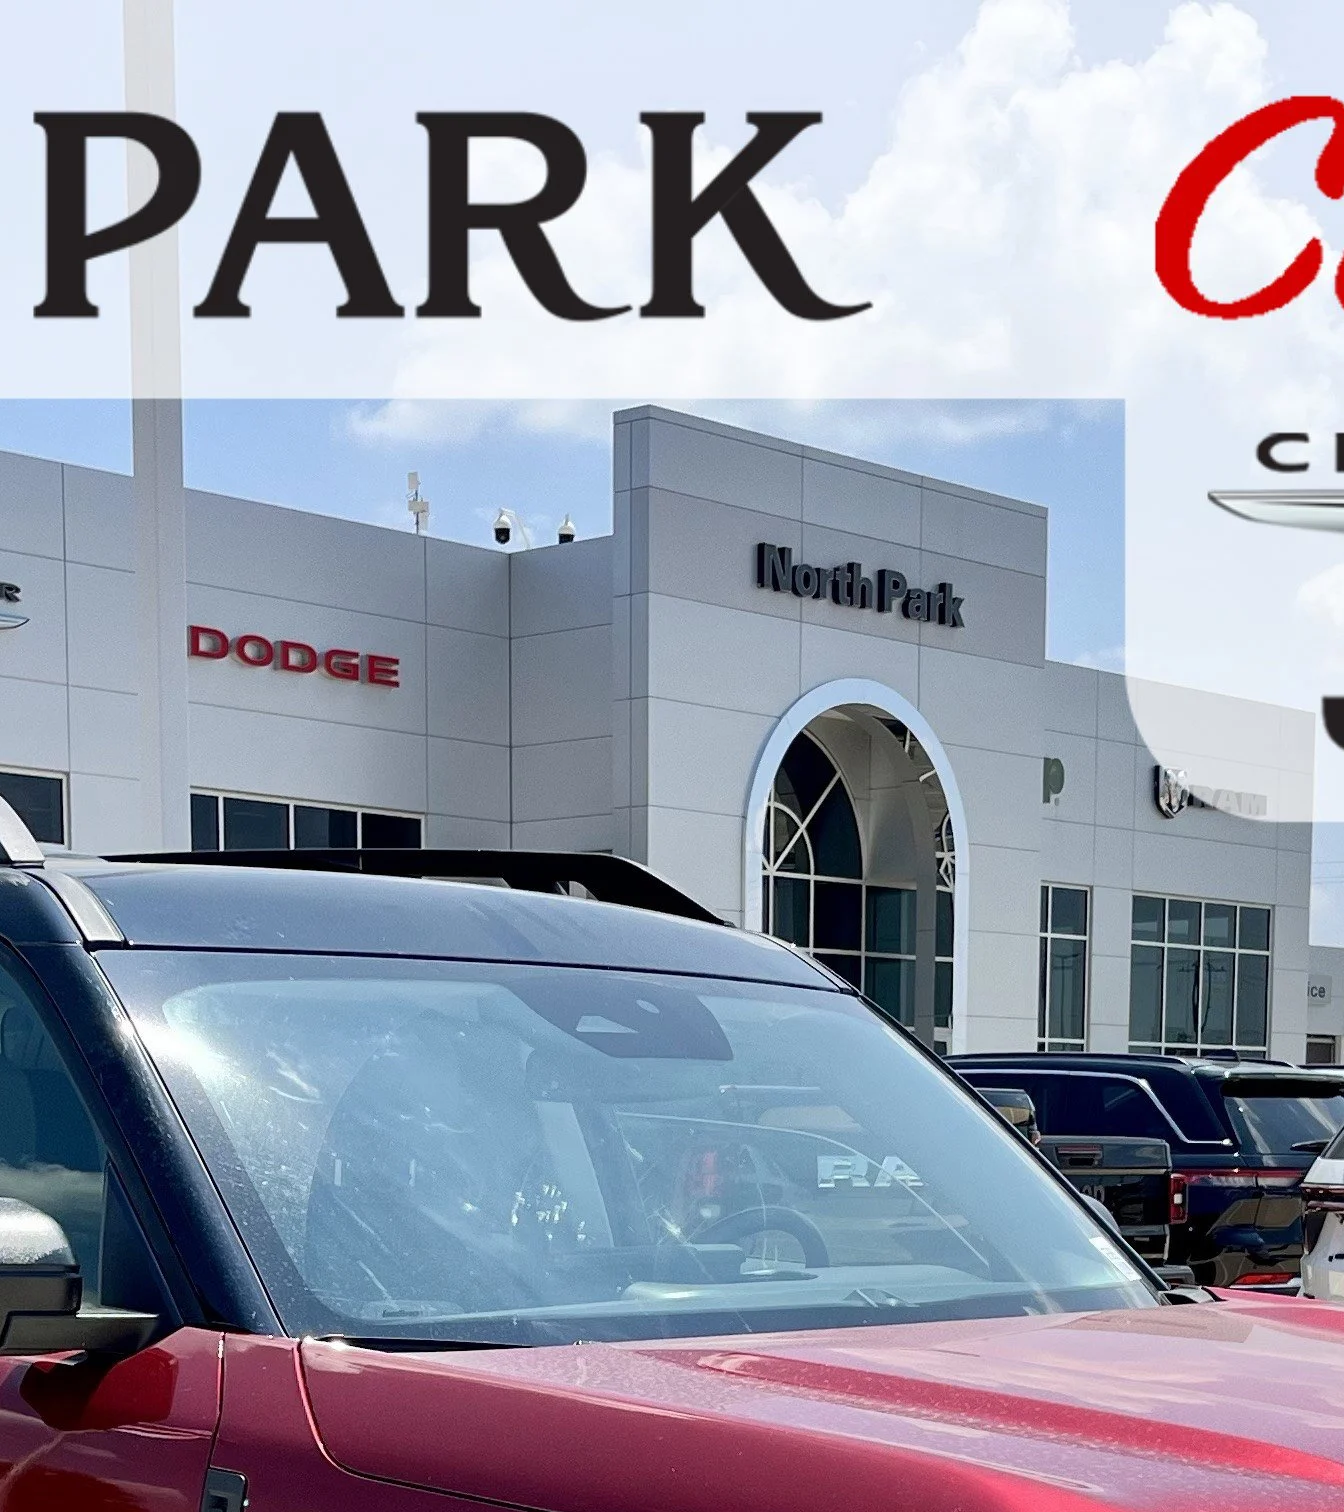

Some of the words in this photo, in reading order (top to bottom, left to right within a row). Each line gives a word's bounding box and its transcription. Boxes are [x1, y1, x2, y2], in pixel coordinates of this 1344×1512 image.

[756, 541, 873, 610] North
[876, 569, 966, 628] Park
[187, 624, 401, 689] DODGE
